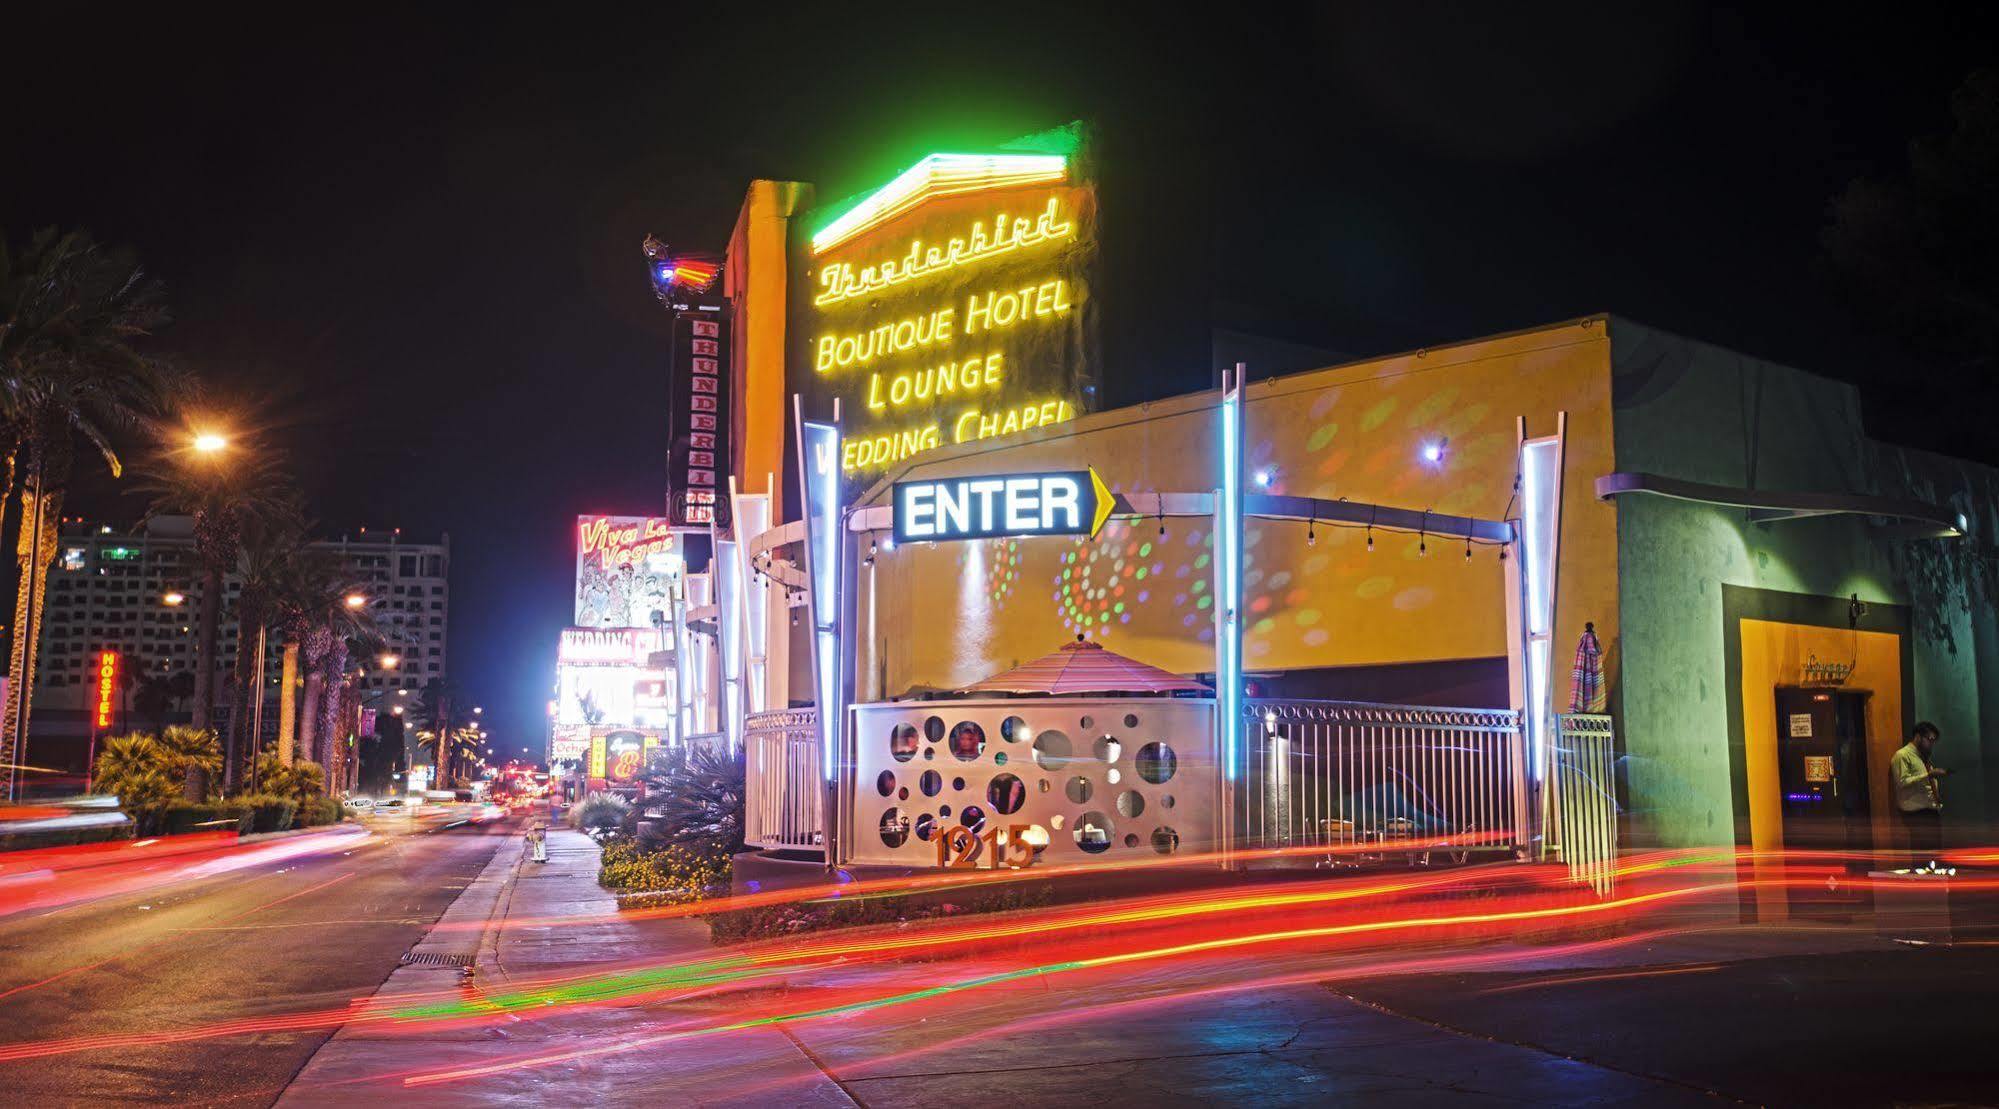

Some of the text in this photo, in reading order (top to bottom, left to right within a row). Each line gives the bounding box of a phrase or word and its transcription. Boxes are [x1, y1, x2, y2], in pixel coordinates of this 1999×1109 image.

[814, 197, 1070, 305] Thunderbird
[816, 281, 1071, 372] BOUTIQUE HOTEL
[868, 353, 1003, 409] LOUNGE
[905, 477, 1079, 536] ENTER
[581, 518, 669, 553] Viva La
[602, 537, 673, 570] Vegas
[99, 653, 115, 726] HOSTEL
[928, 824, 1035, 869] 1215
